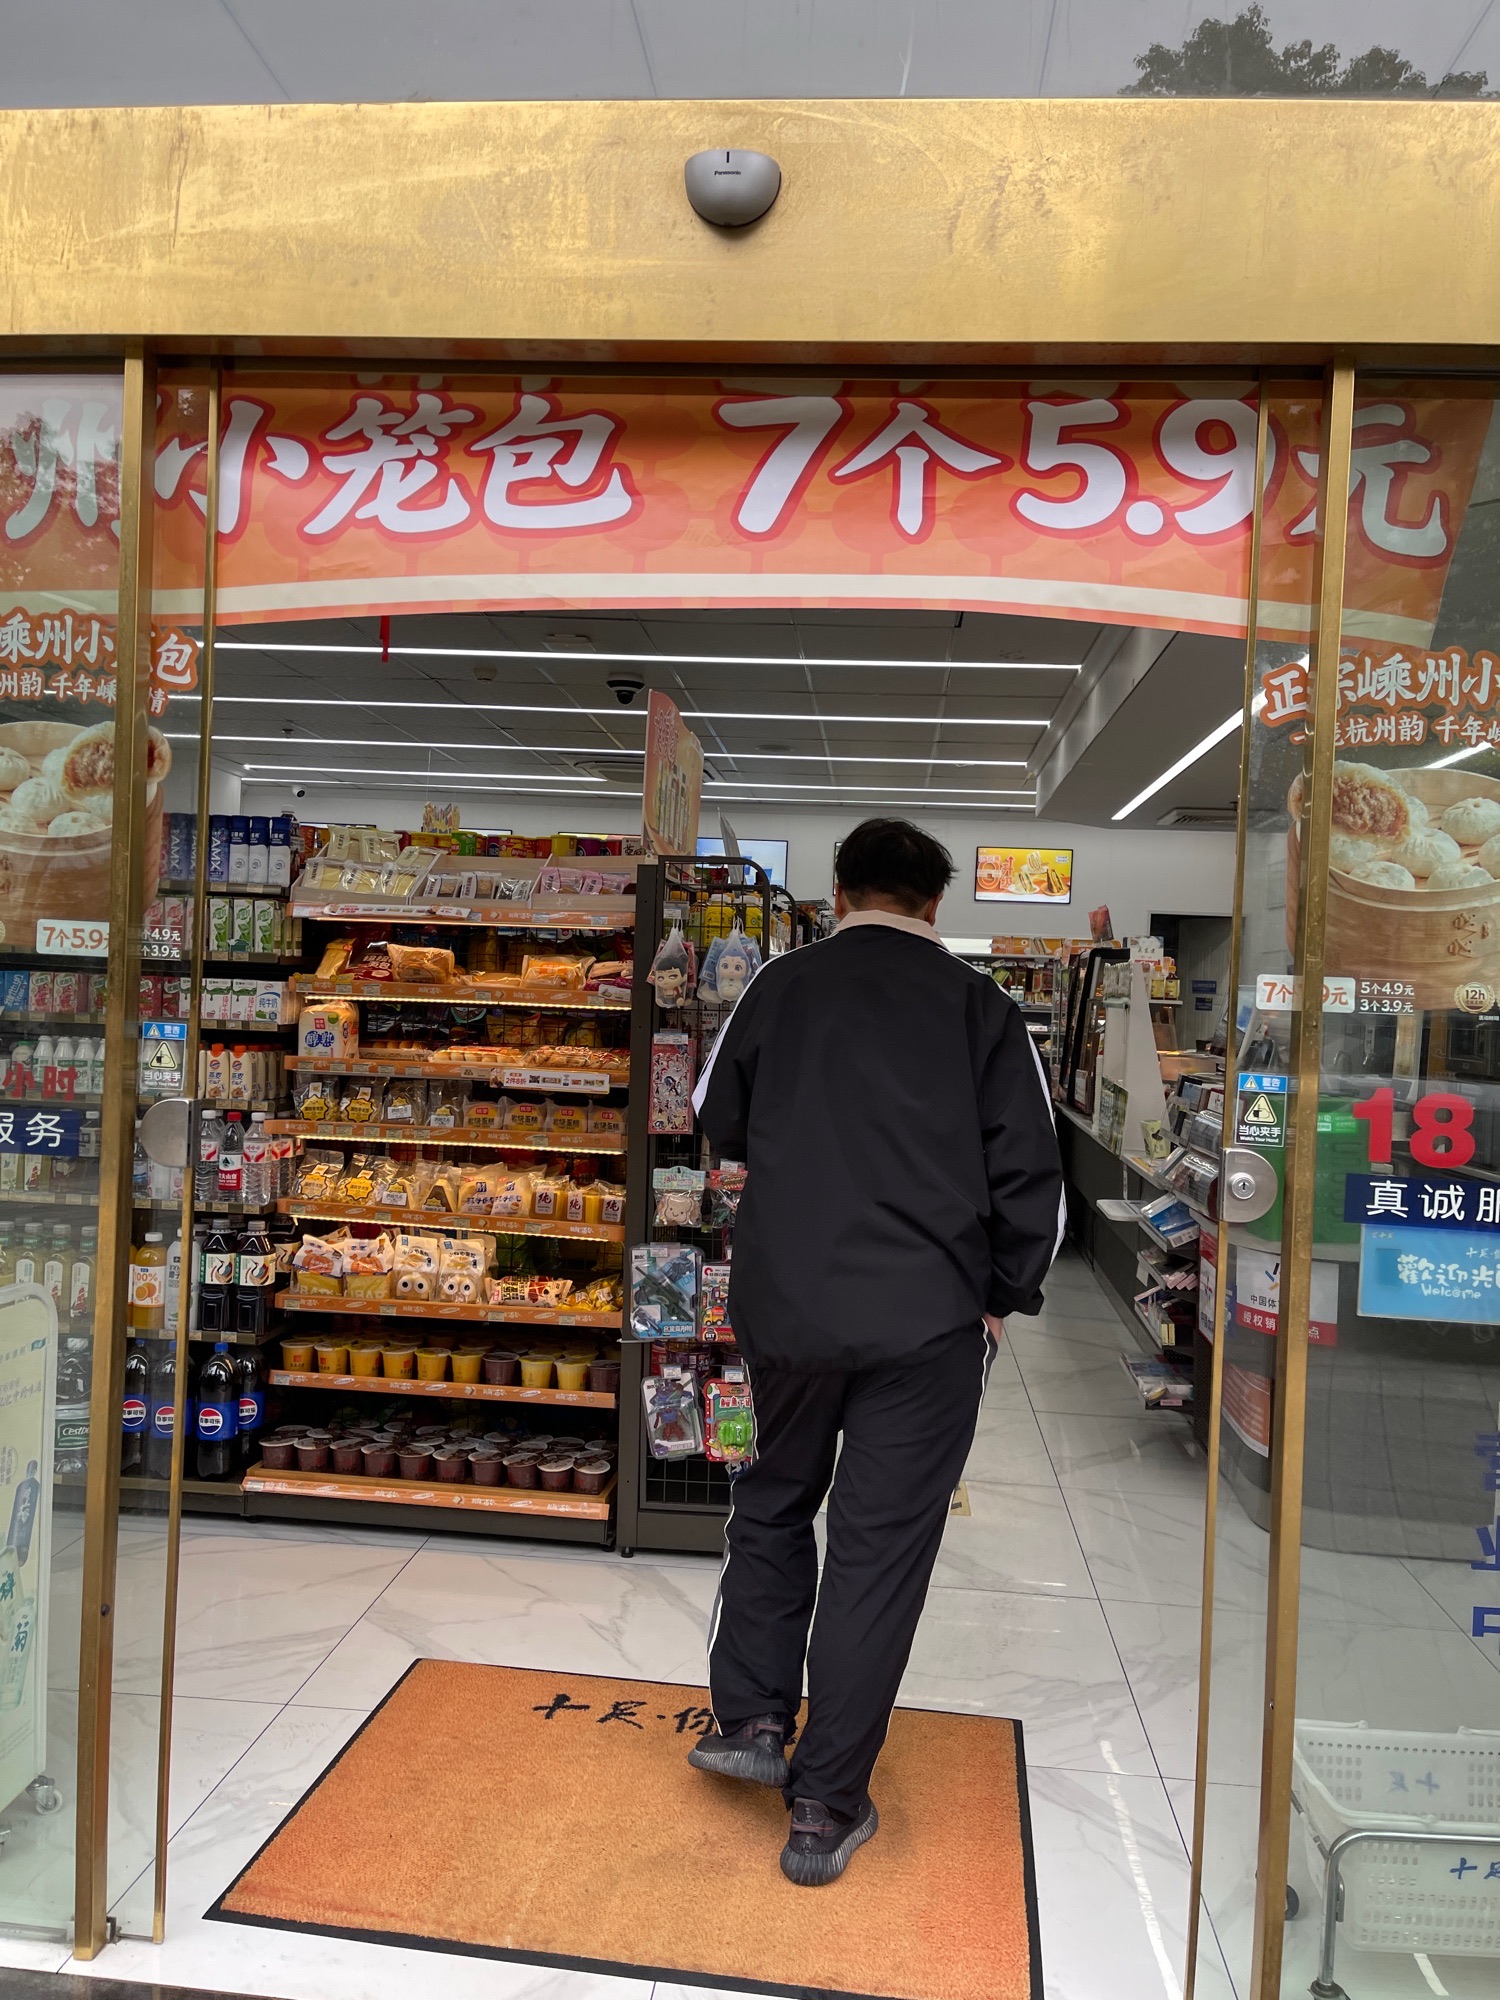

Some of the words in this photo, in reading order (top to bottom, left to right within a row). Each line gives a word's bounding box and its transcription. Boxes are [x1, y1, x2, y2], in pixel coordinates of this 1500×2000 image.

[718, 396, 1449, 558] 7个5.9元
[0, 613, 193, 685] 嵊州小包
[43, 926, 109, 950] 7个5.9
[1360, 981, 1415, 997] 5个4.9元
[1464, 989, 1486, 1001] 12h
[1359, 999, 1414, 1014] 3个3.9元
[2, 1061, 78, 1103] 小时
[1262, 1077, 1280, 1087] 警告
[1239, 1125, 1282, 1138] 当心夹手
[1353, 1088, 1476, 1169] 18
[1420, 1282, 1482, 1300] Welcome
